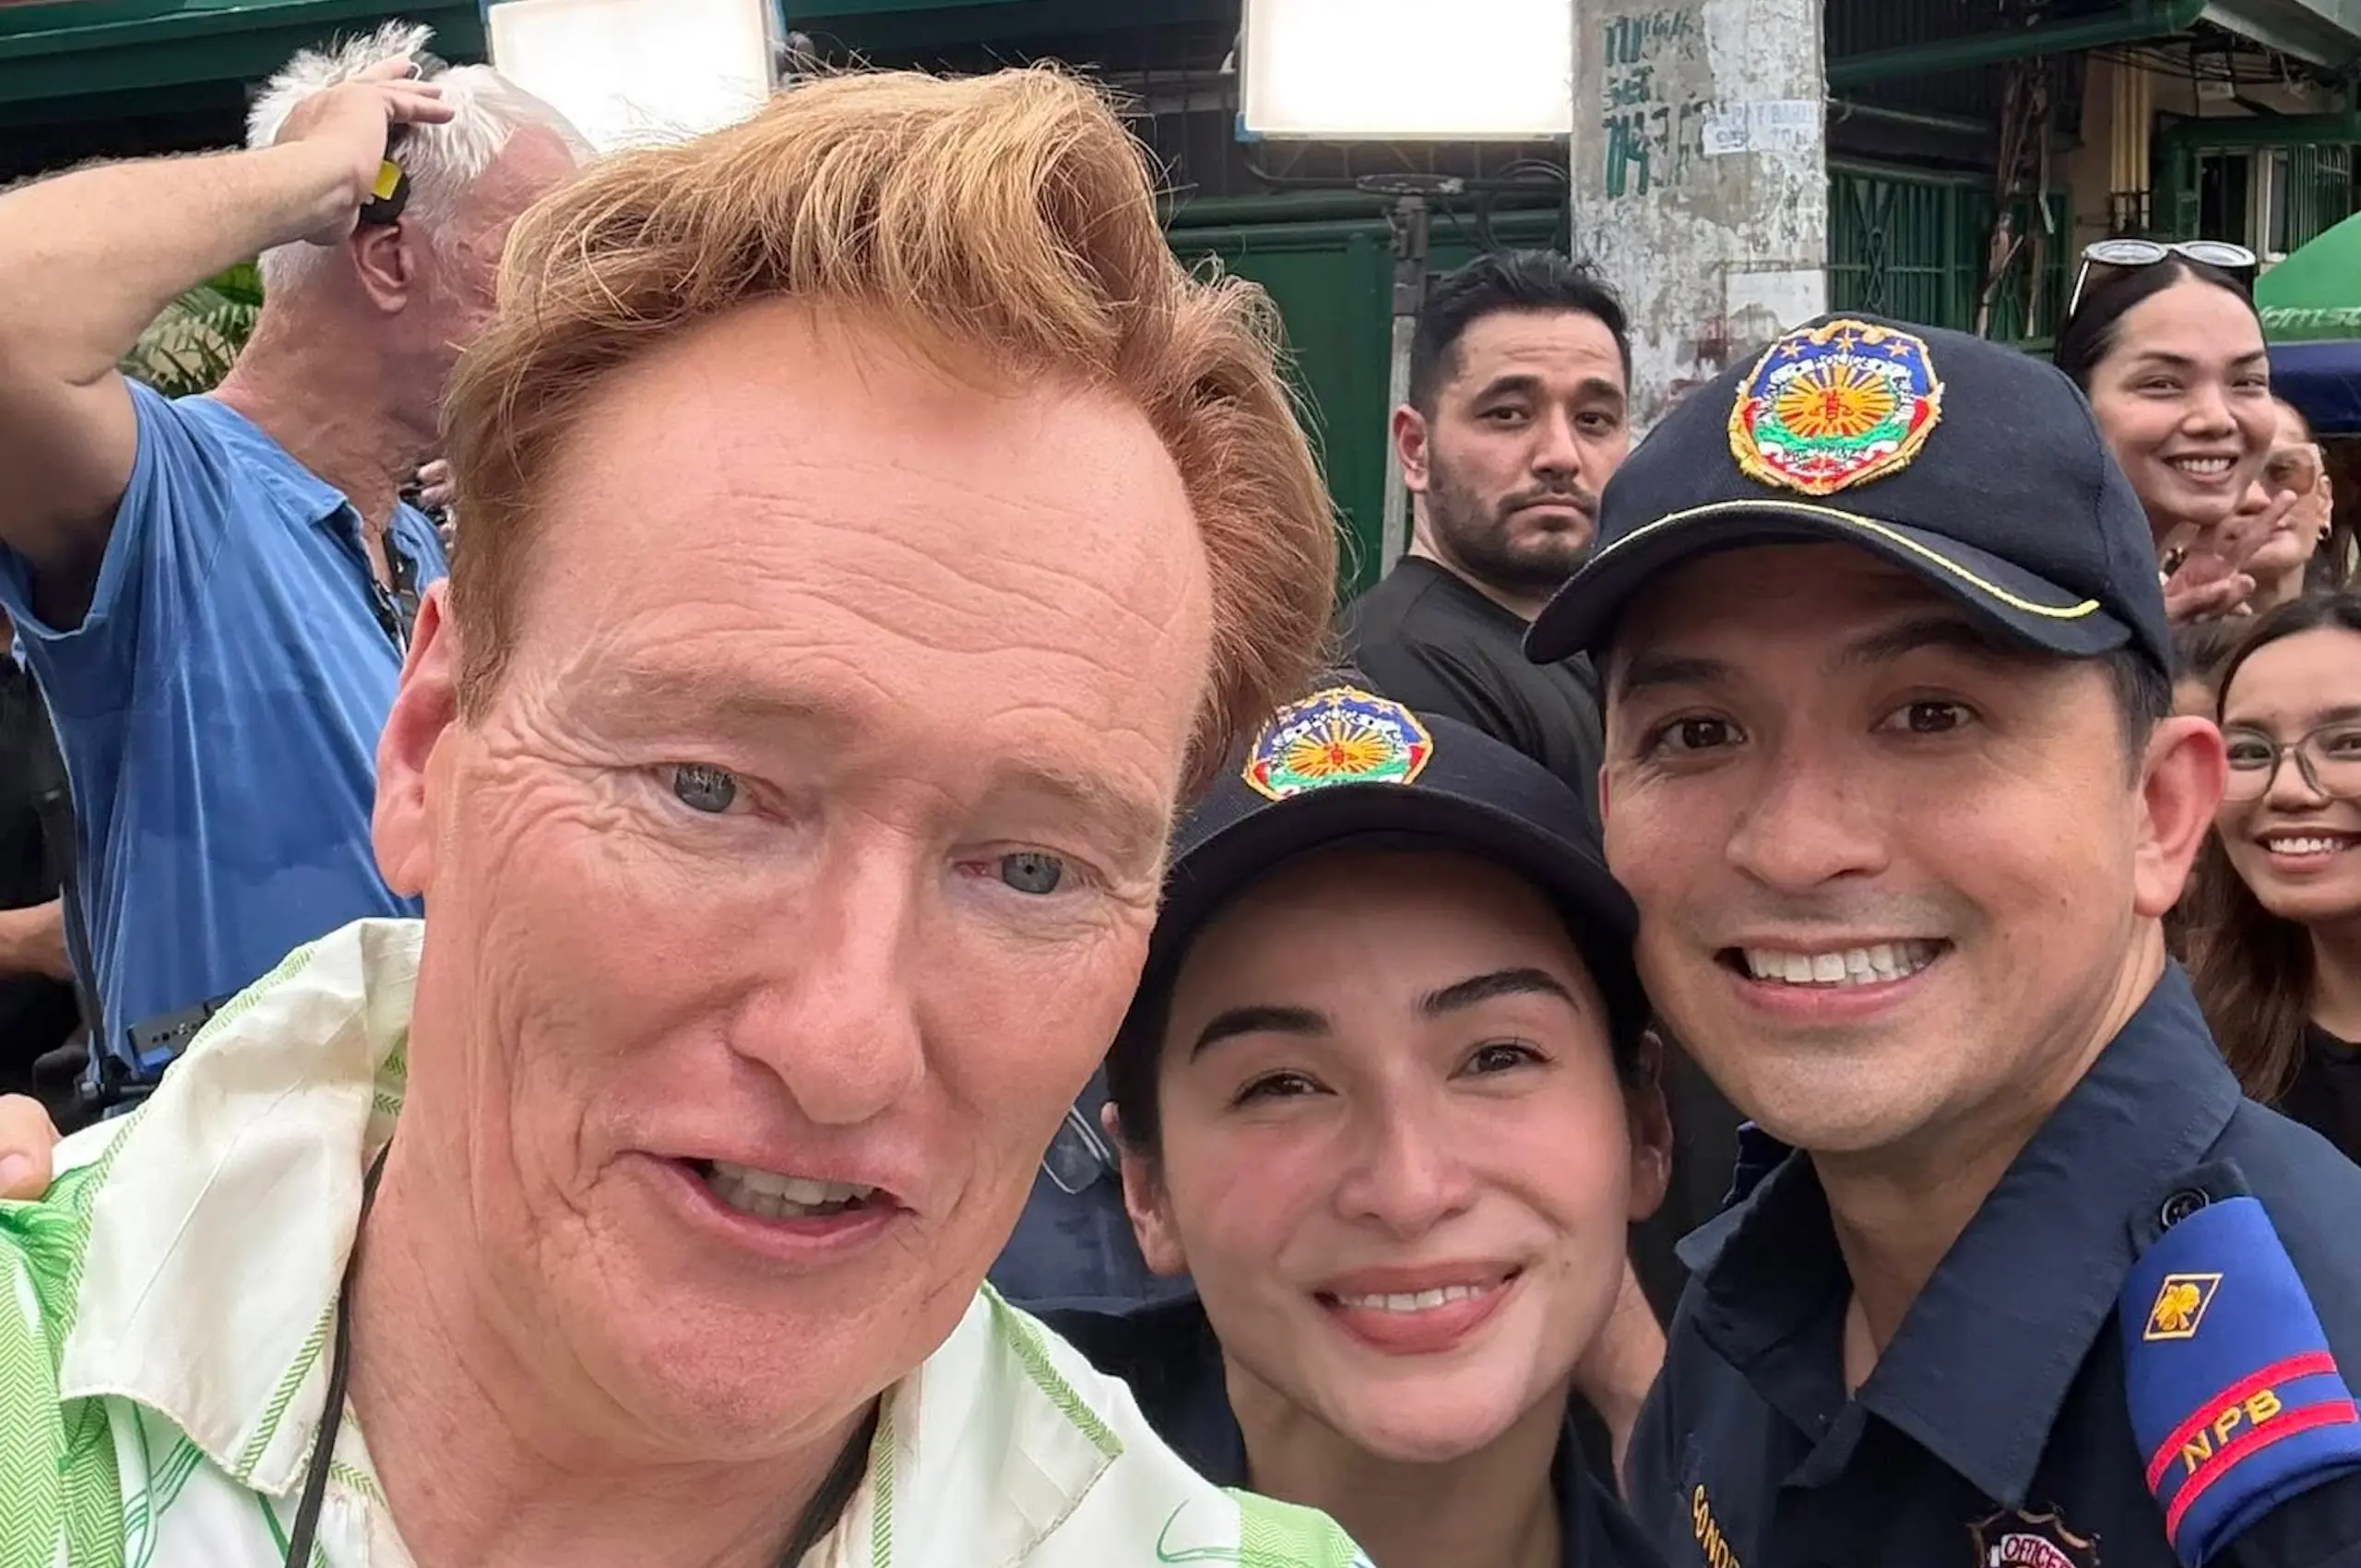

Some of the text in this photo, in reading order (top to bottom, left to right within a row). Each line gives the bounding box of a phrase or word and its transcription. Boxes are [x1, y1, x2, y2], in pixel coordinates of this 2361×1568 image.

[2182, 1389, 2283, 1475] NPB
[1693, 1484, 1741, 1568] COND
[2004, 1535, 2071, 1568] OFFICE
